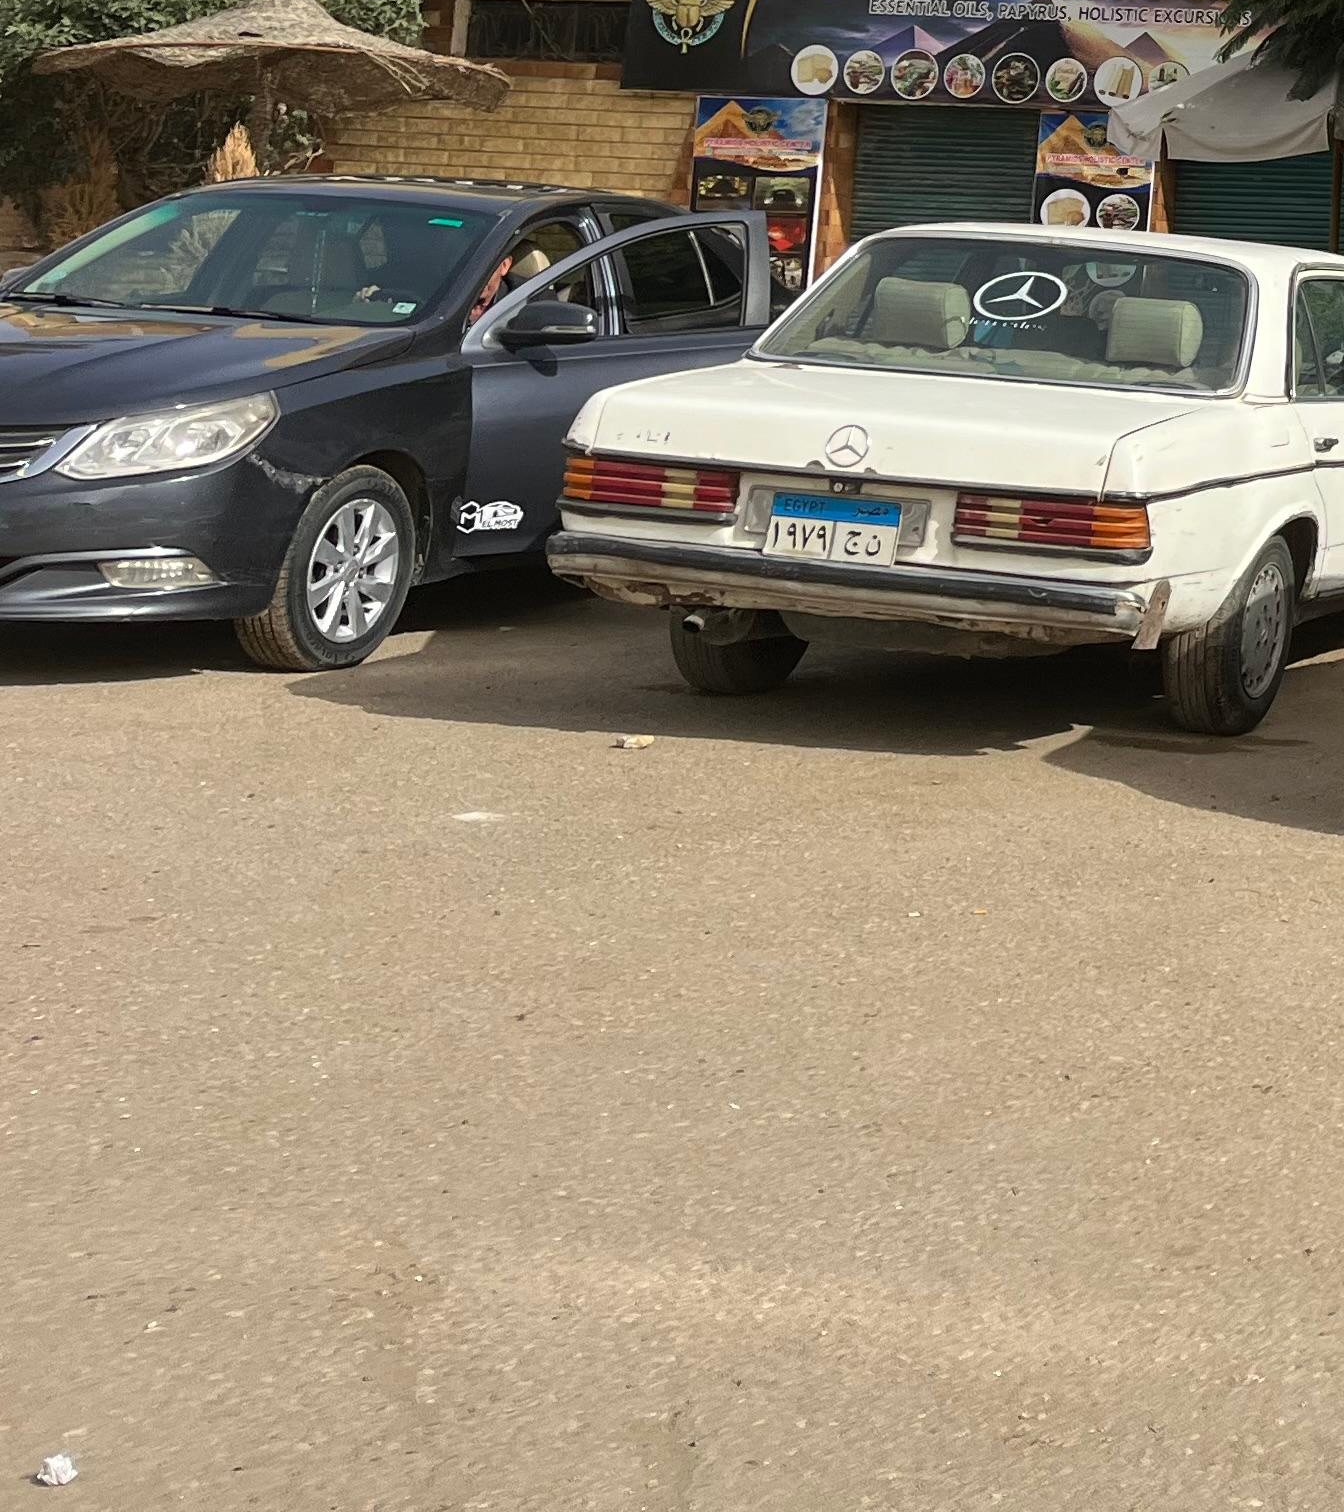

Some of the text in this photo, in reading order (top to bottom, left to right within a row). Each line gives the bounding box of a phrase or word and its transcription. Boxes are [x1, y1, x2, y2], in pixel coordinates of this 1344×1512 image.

[954, 0, 993, 21] OILS,
[997, 4, 1072, 23] PAPYRUS,
[1078, 6, 1148, 23] HOLISTIC
[1153, 7, 1252, 27] EXCURSIS
[784, 498, 827, 513] EGYPT
[851, 506, 890, 517] مصر
[773, 521, 828, 553] ١٩٧٩
